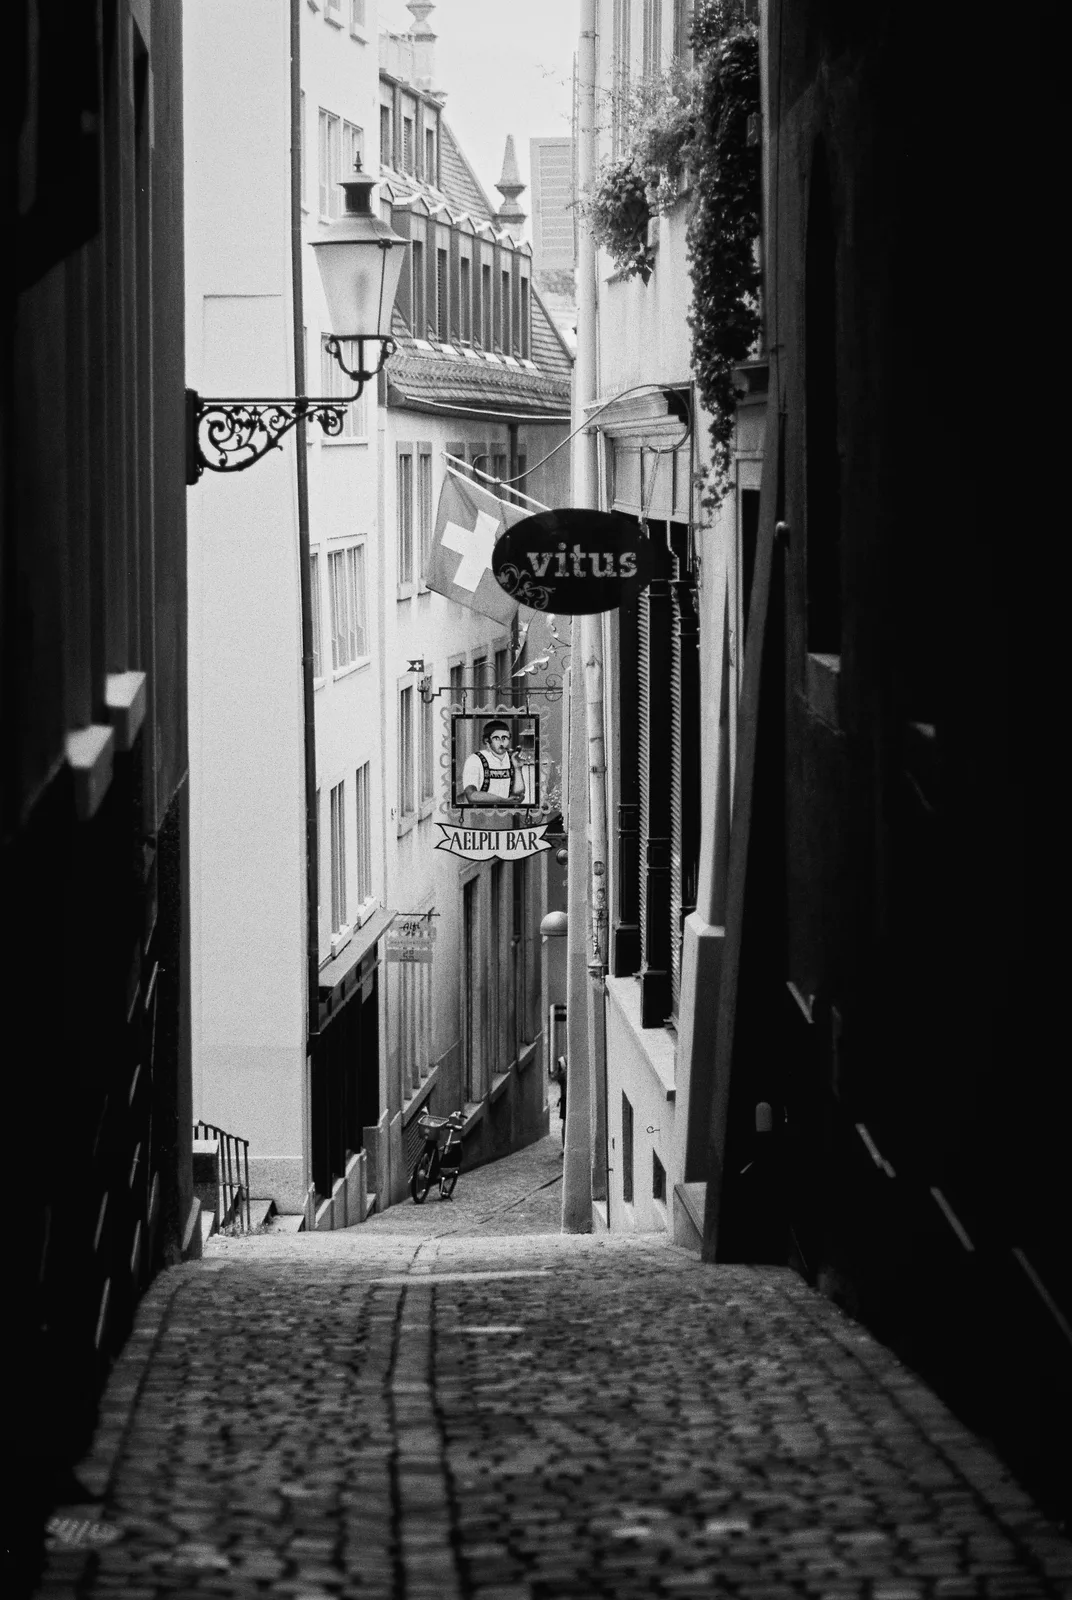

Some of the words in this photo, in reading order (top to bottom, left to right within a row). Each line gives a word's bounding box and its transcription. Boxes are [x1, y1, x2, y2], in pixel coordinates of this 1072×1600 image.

[526, 542, 638, 578] vitus
[449, 831, 500, 851] AELPLI
[506, 831, 539, 851] BAR
